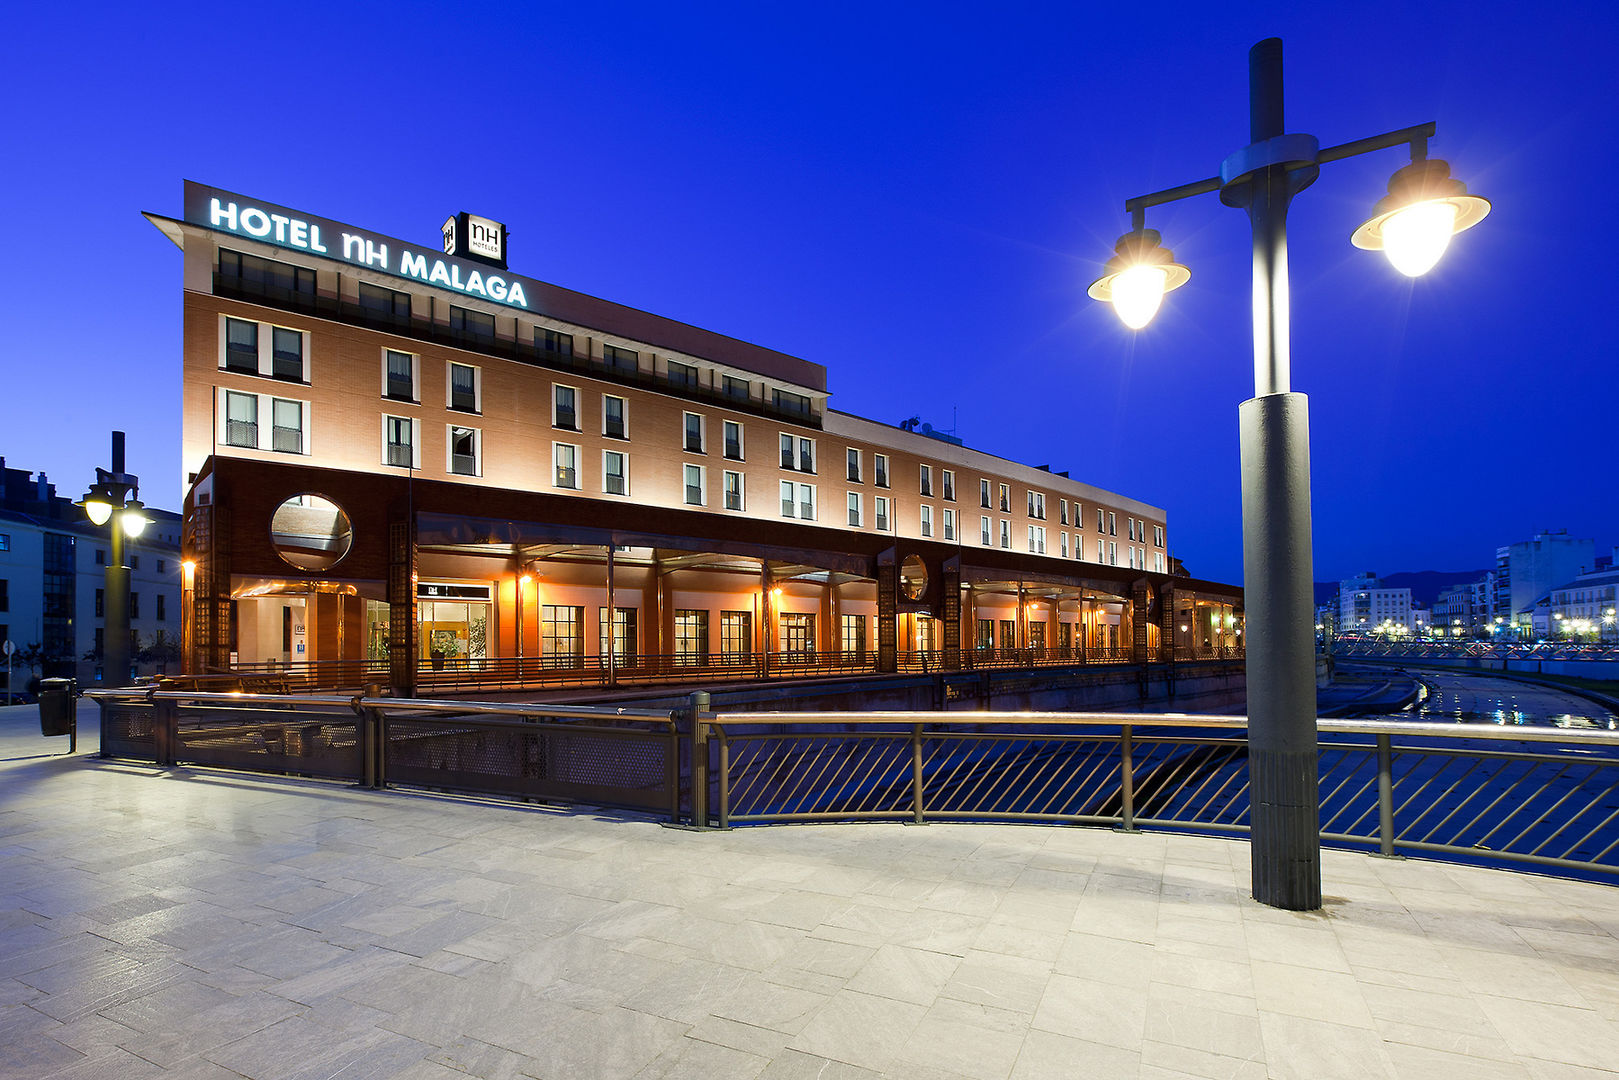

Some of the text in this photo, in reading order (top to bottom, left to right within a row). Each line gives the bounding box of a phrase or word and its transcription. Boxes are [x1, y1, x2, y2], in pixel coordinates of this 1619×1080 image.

[210, 197, 327, 253] HOTEL
[400, 251, 528, 307] MALAGA
[473, 241, 498, 252] HOTELES
